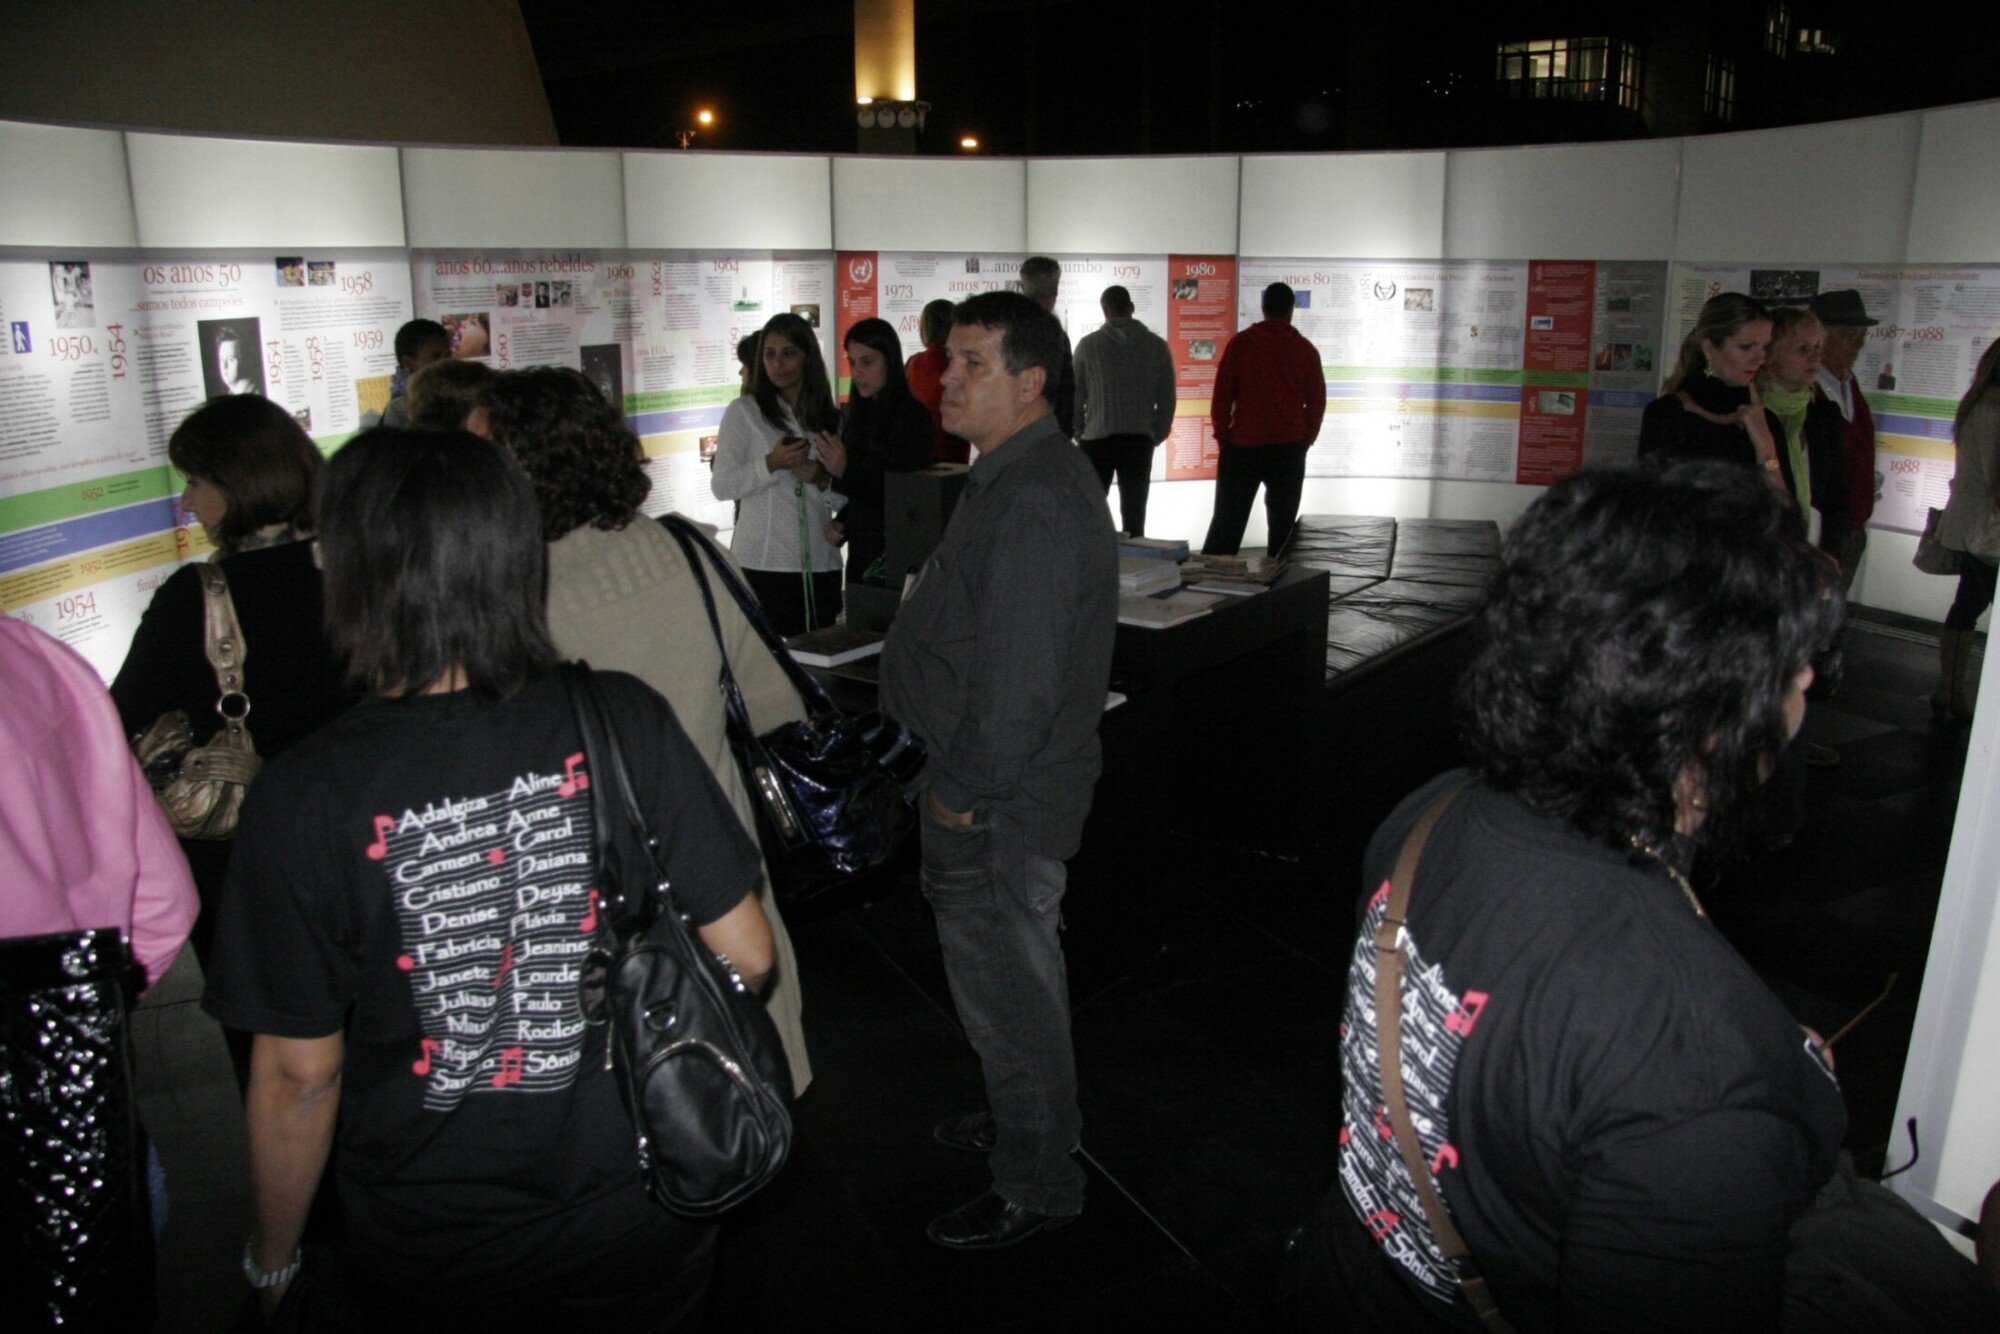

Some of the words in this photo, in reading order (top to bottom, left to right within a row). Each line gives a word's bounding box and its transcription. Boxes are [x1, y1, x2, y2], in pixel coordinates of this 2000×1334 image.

[143, 265, 167, 285] os
[170, 264, 215, 284] anos
[218, 263, 242, 287] 50
[436, 259, 469, 275] anos
[539, 254, 595, 273] rebeldes
[605, 264, 635, 281] 1960
[713, 258, 740, 275] 1964
[1113, 266, 1141, 279] 1979
[1185, 263, 1216, 276] 1980
[1282, 274, 1311, 285] anos
[1313, 272, 1330, 285] 80
[341, 271, 373, 296] 1958
[884, 284, 914, 298] 1973
[949, 281, 979, 292] anos
[982, 281, 999, 292] 70
[170, 296, 198, 311] todos
[49, 335, 93, 361] 1950
[107, 322, 128, 381] 1954
[352, 330, 384, 351] 1959
[267, 337, 283, 385] 1954
[306, 336, 325, 382] 1958
[1890, 459, 1921, 474] 1988
[56, 591, 97, 622] 1954
[508, 772, 563, 801] Aline
[398, 797, 489, 834] Adalgiza
[505, 805, 561, 833] Anne
[419, 822, 498, 857] Andrea
[515, 817, 573, 851] Carol
[397, 852, 481, 883] Carmen
[516, 852, 588, 880] Daiana
[402, 876, 500, 910] Cristiano
[516, 882, 583, 910] Deyse
[421, 905, 499, 936] Denise
[511, 909, 567, 937] Flávia
[515, 939, 589, 963] Jeanine
[420, 965, 490, 993] Janete
[513, 963, 580, 989] Lourde
[512, 991, 562, 1013] Paulo
[526, 1050, 581, 1074] Sônia
[1401, 1063, 1440, 1108] aiana
[1339, 1151, 1374, 1211] Sandra
[1385, 1232, 1436, 1286] Sônia
